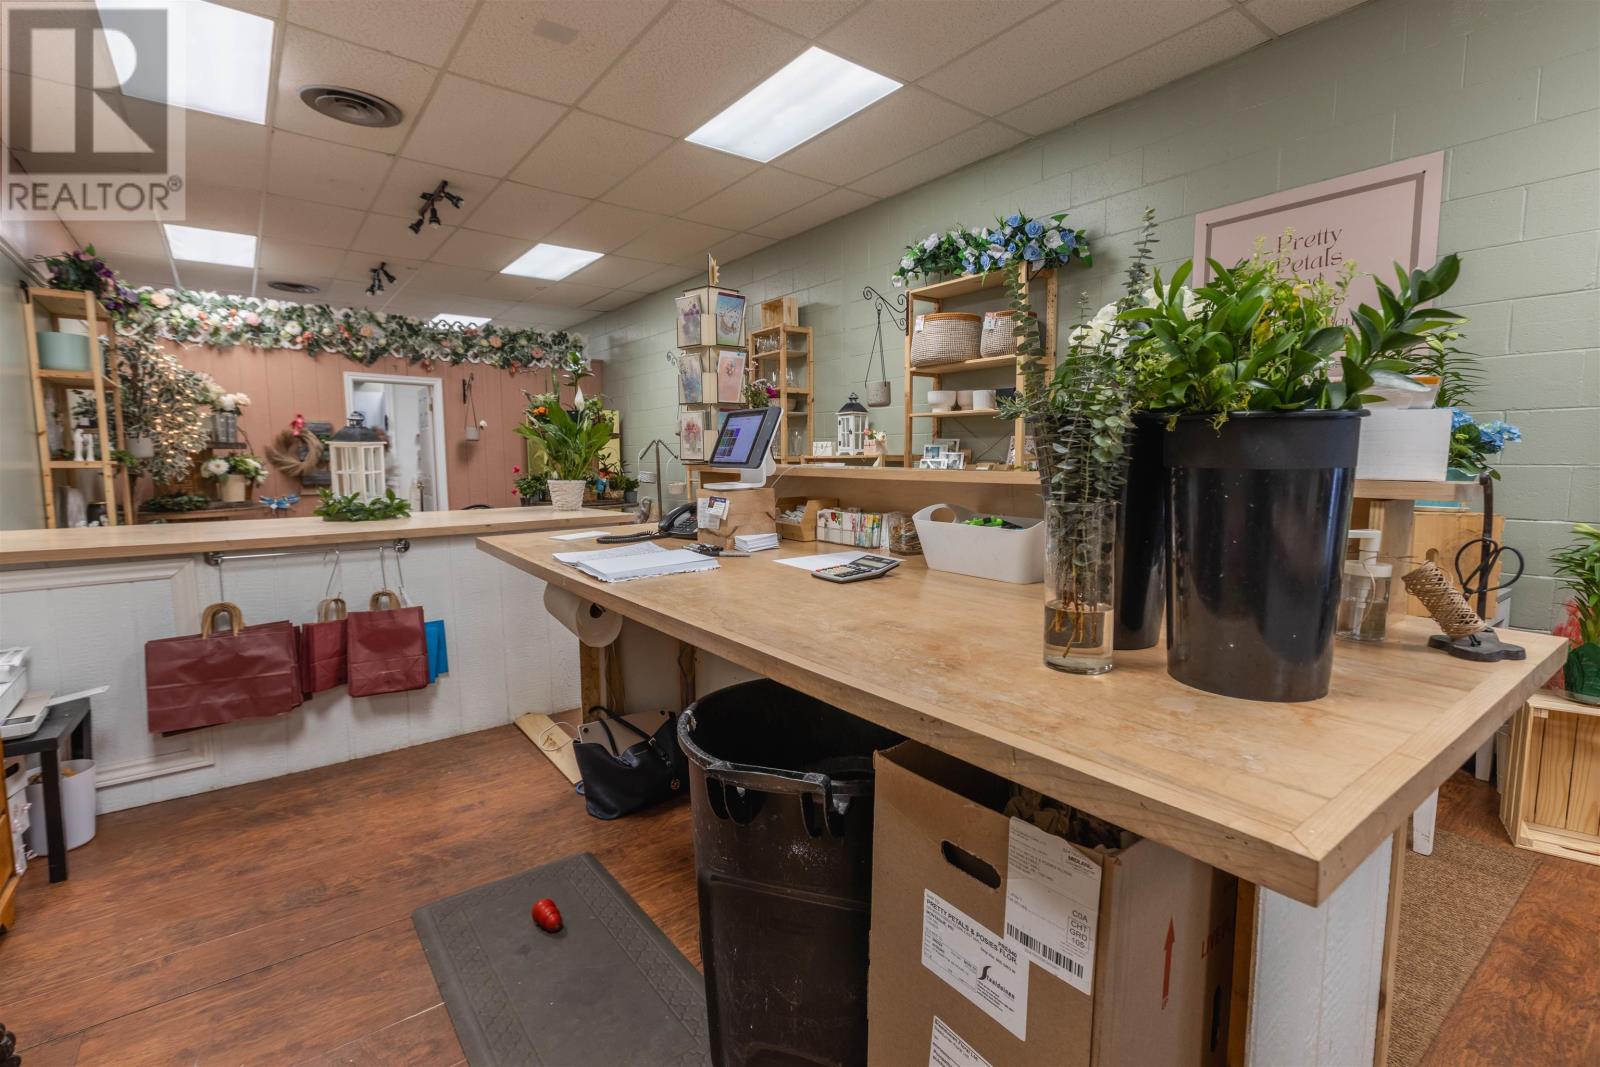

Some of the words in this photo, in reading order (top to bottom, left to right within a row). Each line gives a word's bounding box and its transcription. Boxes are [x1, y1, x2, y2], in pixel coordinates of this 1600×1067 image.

[1277, 227, 1342, 253] Pretty
[1277, 248, 1342, 273] Petals
[926, 898, 947, 917] PRETTY
[947, 912, 968, 932] PETALS
[969, 926, 974, 935] &
[976, 931, 997, 951] POSIES
